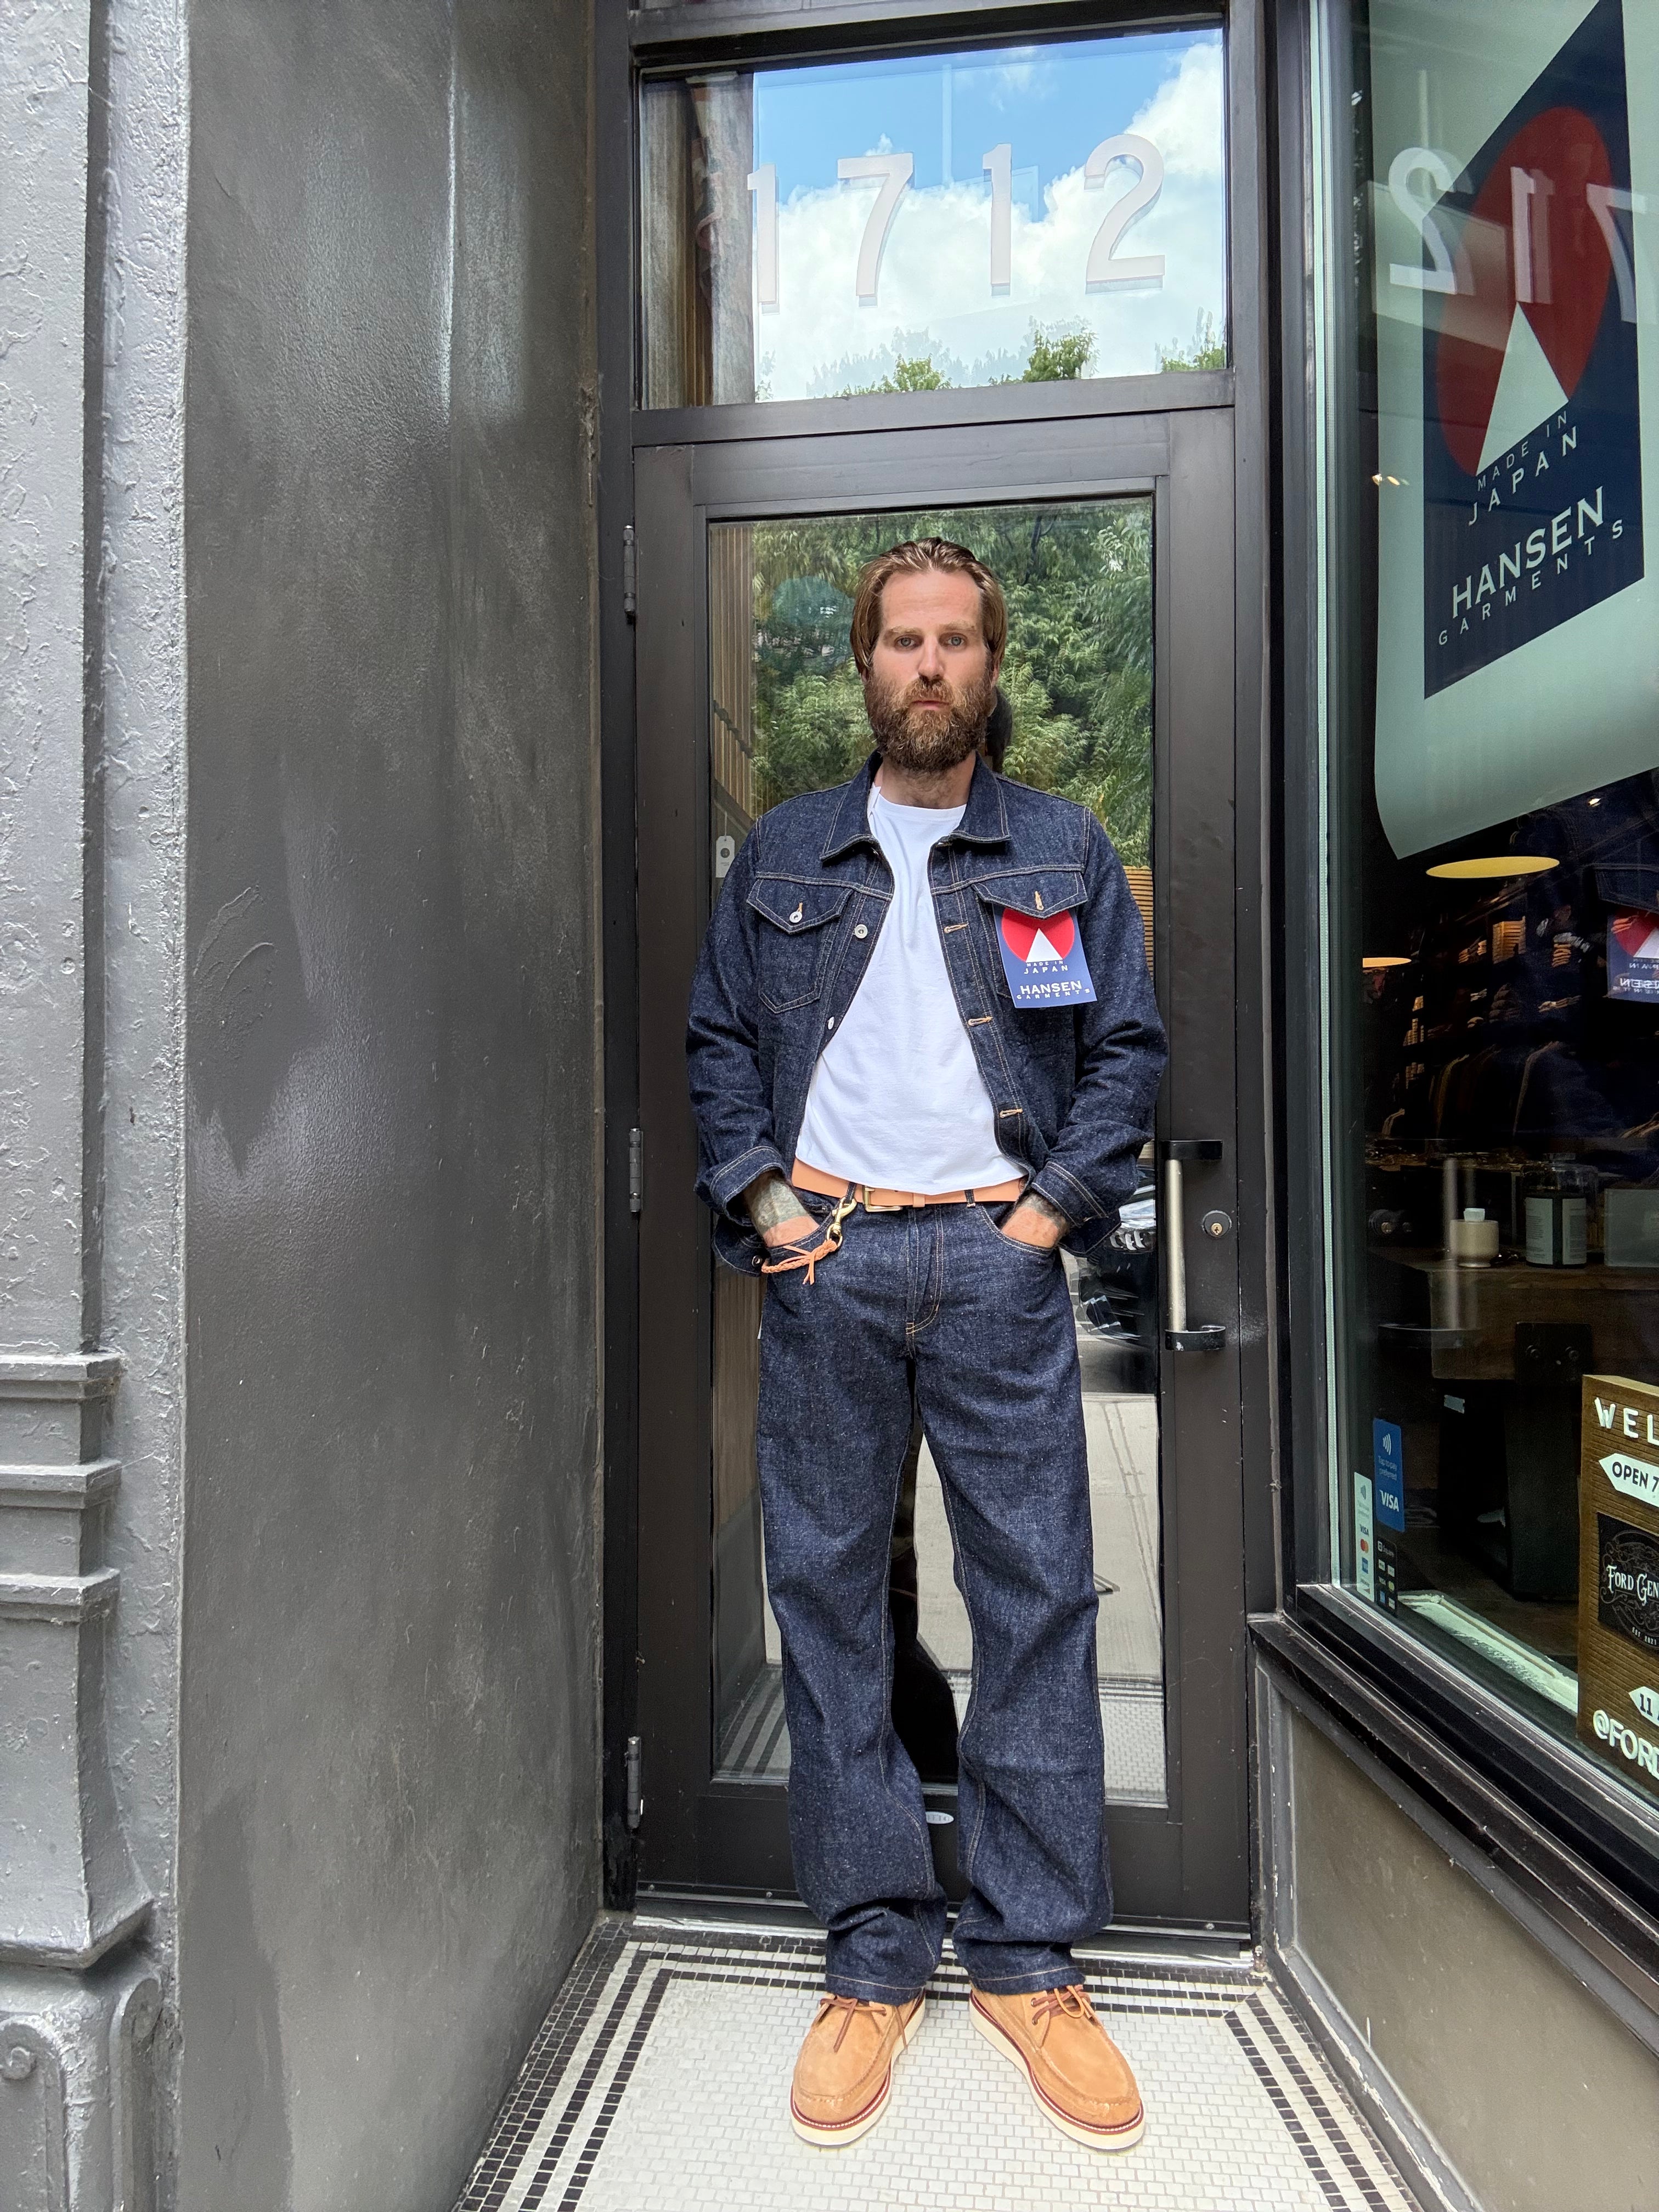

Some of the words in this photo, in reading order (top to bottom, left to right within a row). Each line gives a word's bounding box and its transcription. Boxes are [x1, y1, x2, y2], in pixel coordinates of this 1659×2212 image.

[747, 134, 1165, 305] 1712
[1477, 441, 1528, 492] MADE
[1547, 410, 1567, 438] IN
[1468, 426, 1577, 527] JAPAN
[1452, 486, 1604, 619] HANSEN
[1438, 519, 1623, 646] GARMENTS
[1024, 964, 1068, 974] JAPAN
[1017, 988, 1090, 1000] GARMENTS
[1020, 980, 1082, 995] HANSEN
[1612, 1462, 1649, 1489] OPEN
[1379, 1489, 1400, 1513] VISA
[1632, 1626, 1641, 1638] EST
[1644, 1635, 1657, 1646] 2021
[1640, 1693, 1653, 1717] 11
